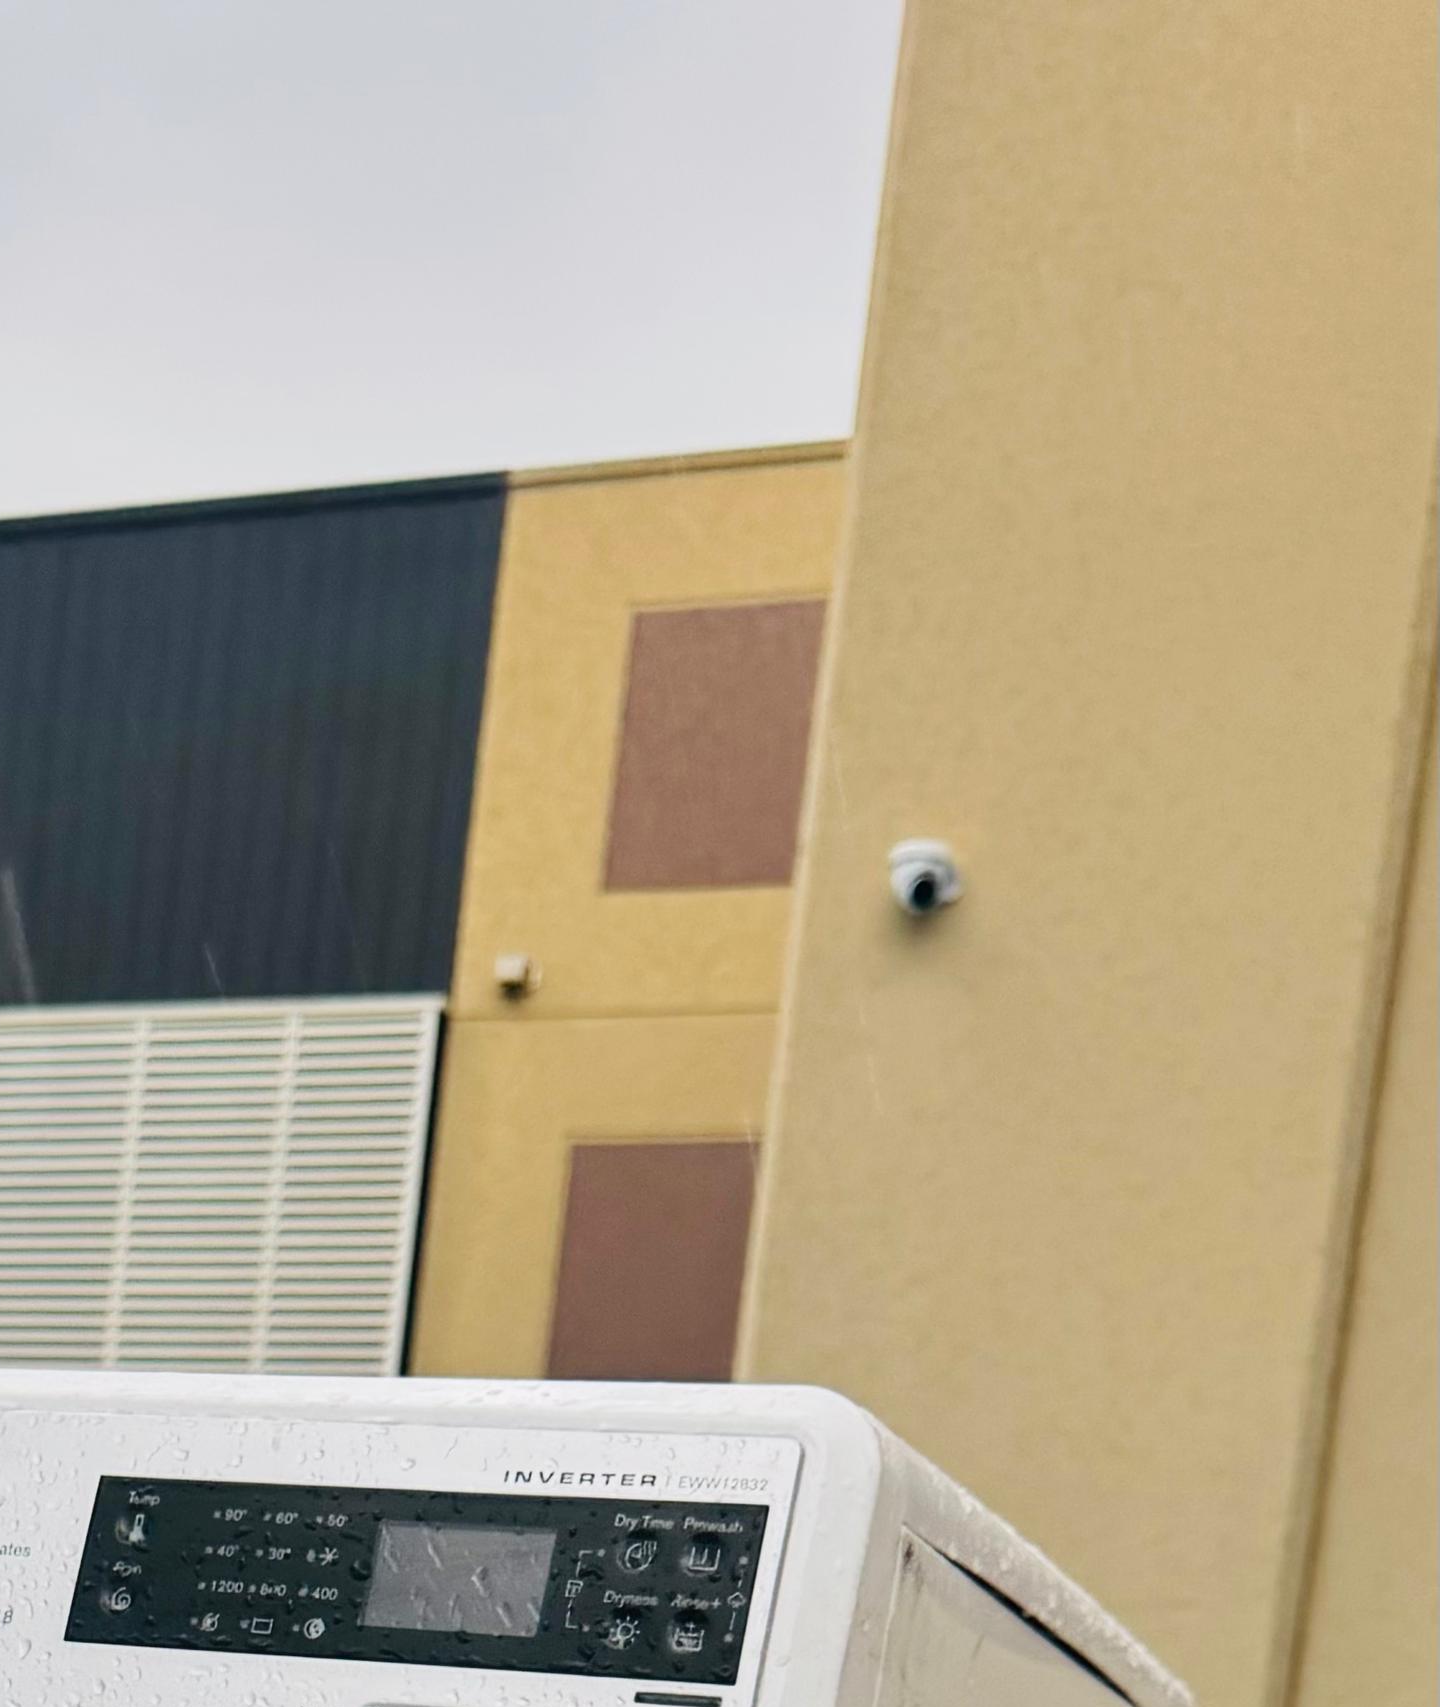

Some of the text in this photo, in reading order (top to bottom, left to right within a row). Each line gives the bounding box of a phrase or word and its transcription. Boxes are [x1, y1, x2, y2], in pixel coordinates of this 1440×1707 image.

[504, 1471, 658, 1487] INVERTER
[614, 1513, 640, 1531] Dry
[641, 1515, 675, 1531] Time
[211, 1581, 244, 1594] 1200
[311, 1587, 338, 1600] 400
